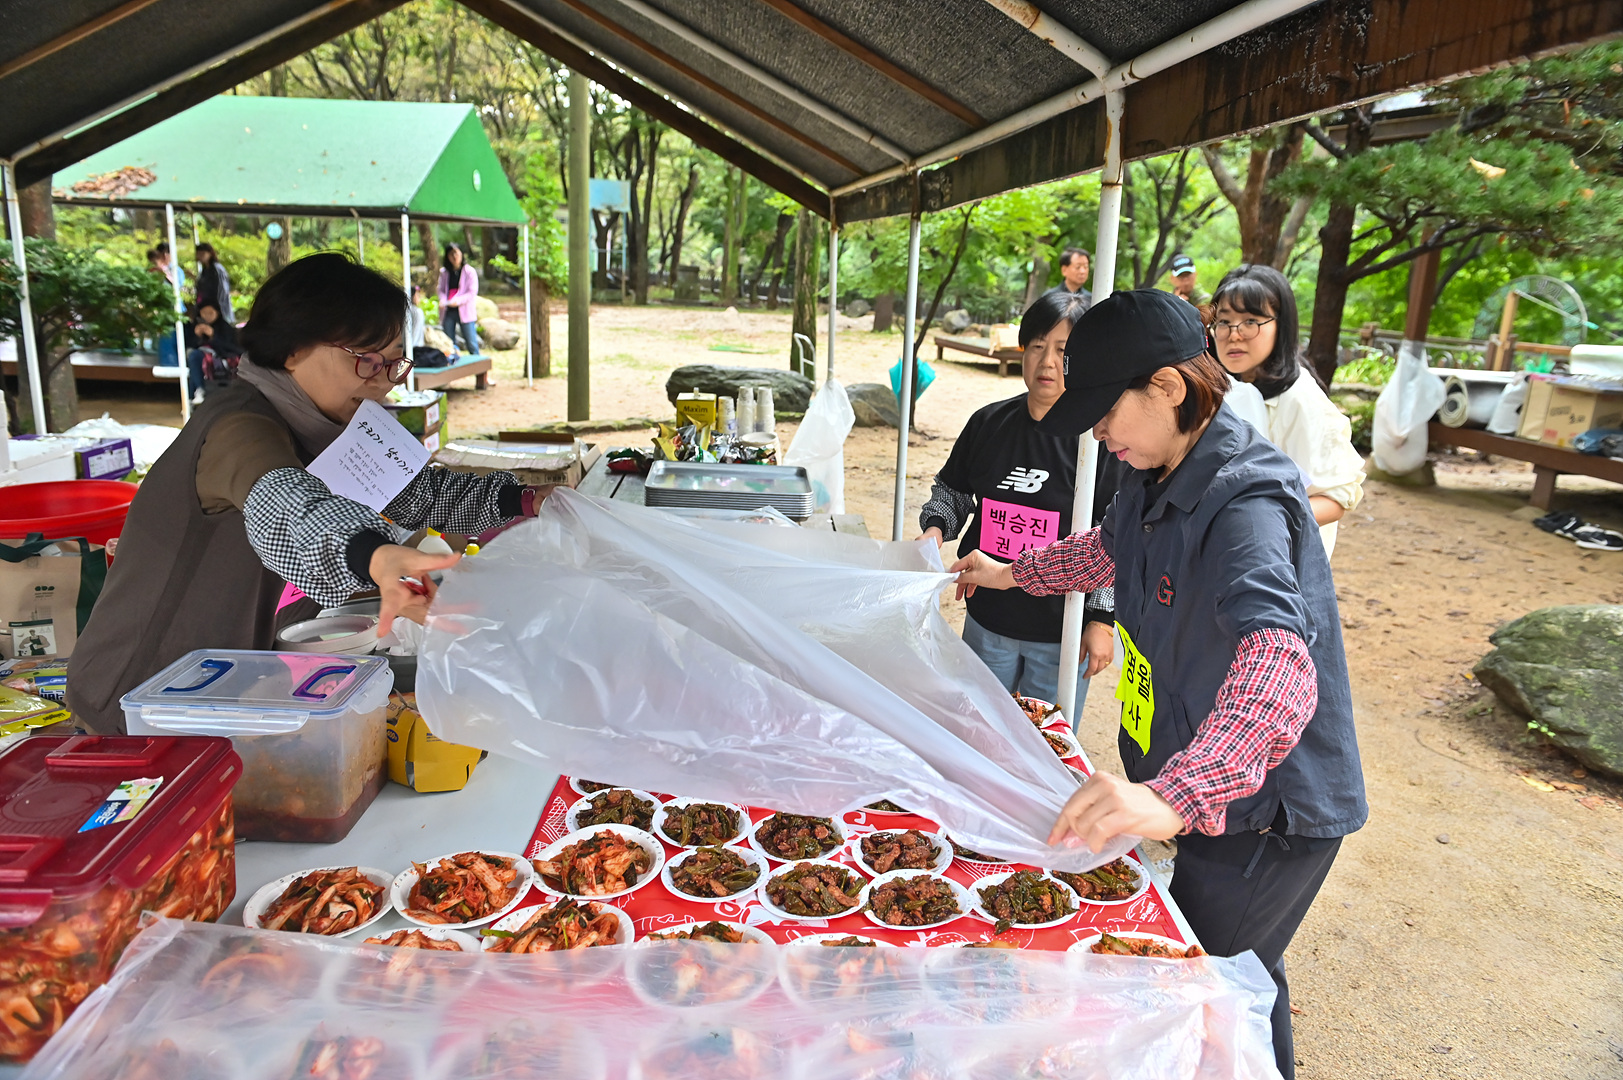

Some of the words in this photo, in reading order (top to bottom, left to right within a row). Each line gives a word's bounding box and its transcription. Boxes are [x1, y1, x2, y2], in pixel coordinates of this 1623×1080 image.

[683, 404, 709, 414] Maxim
[357, 421, 384, 445] 우리가
[384, 447, 414, 477] 남이가?
[990, 508, 1049, 538] 백승진
[996, 536, 1011, 555] 권
[1157, 575, 1174, 607] G
[1128, 700, 1142, 731] 사
